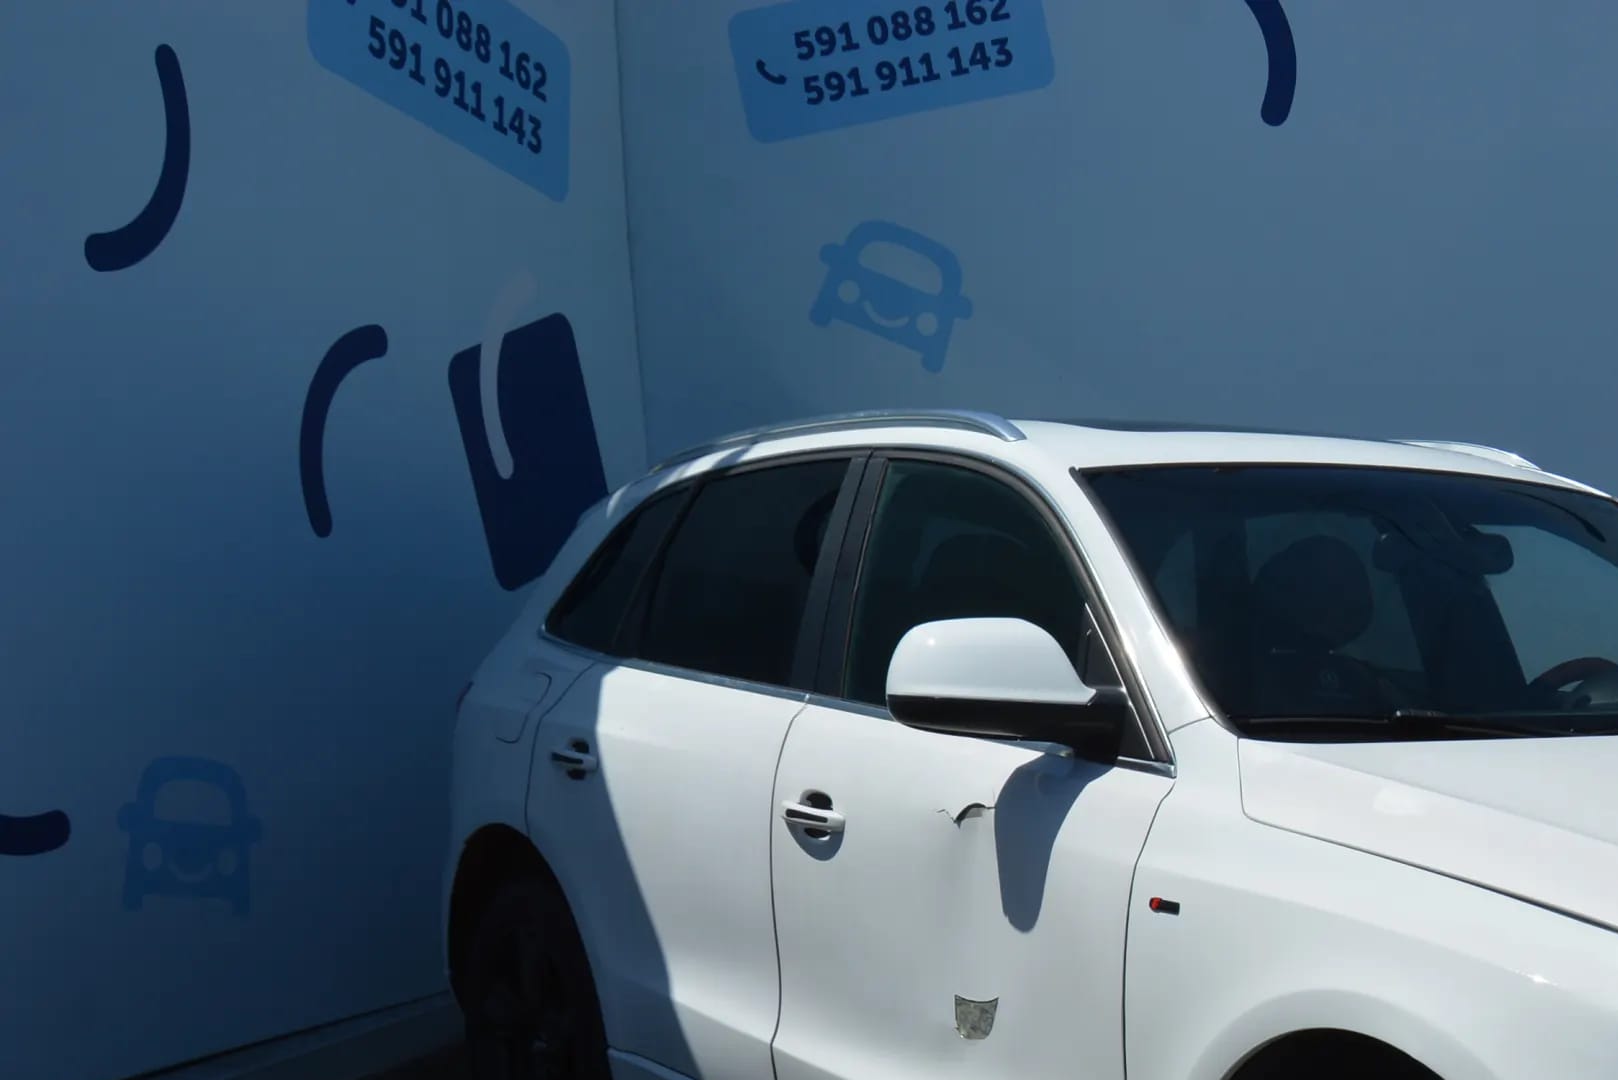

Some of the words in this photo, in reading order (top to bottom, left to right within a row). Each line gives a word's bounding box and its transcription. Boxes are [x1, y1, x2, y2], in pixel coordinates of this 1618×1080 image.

[436, 0, 492, 64] 088
[498, 40, 548, 103] 162
[793, 22, 861, 61] 591
[866, 6, 936, 46] 088
[943, 0, 1011, 32] 162
[803, 66, 870, 105] 591
[875, 52, 941, 92] 911
[946, 36, 1014, 78] 143
[367, 15, 427, 86] 591
[433, 57, 487, 123] 911
[492, 95, 543, 155] 143
